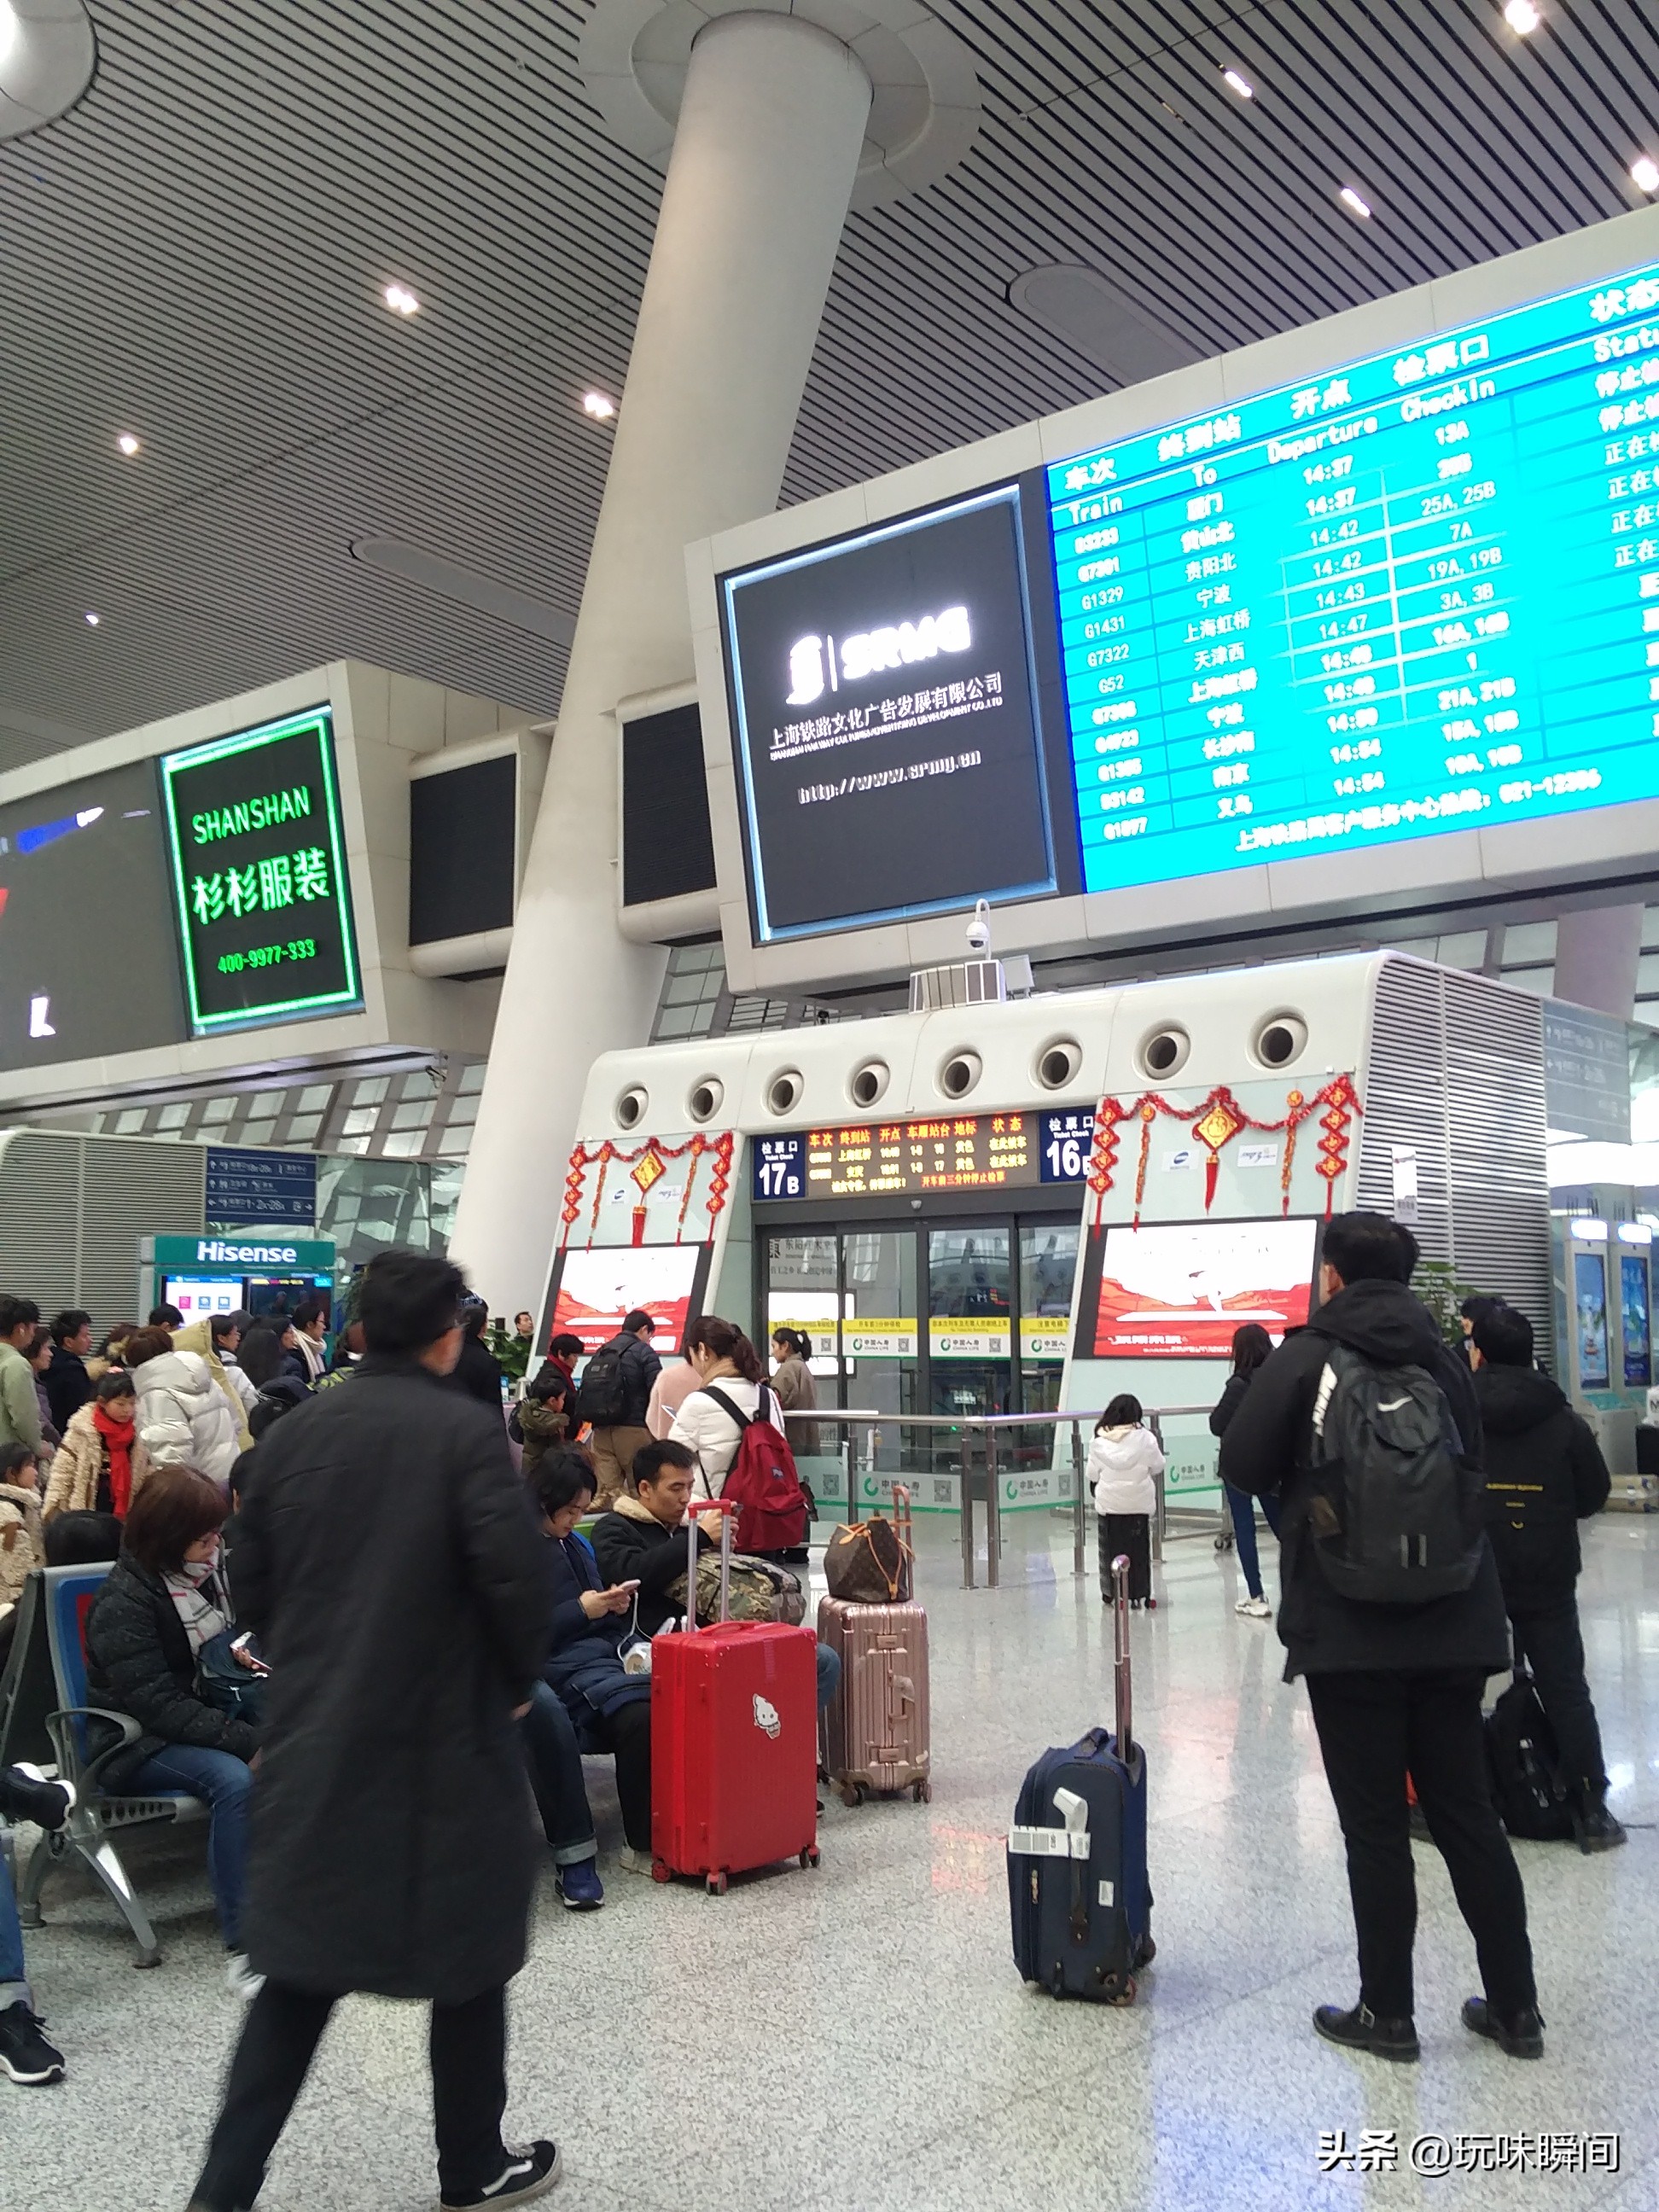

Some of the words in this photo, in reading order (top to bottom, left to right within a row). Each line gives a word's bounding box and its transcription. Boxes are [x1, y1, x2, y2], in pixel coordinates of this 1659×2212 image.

[1064, 457, 1117, 491] 车次
[1291, 378, 1352, 421] 开点
[1393, 334, 1489, 387] 检票口
[1588, 277, 1659, 323] 状态
[1069, 494, 1123, 525] Train
[1191, 464, 1218, 487] To
[1267, 414, 1377, 464] Departure
[1303, 455, 1353, 486] 14:37
[1306, 486, 1357, 517] 14:37
[1081, 586, 1124, 610] G1329
[1185, 552, 1237, 582] 贵阳北
[1310, 519, 1359, 547] 14:42
[1421, 493, 1459, 517] 25A,
[1462, 480, 1497, 505] 25B
[1085, 615, 1126, 639] G1431
[1196, 584, 1231, 608] 宁波
[1313, 550, 1362, 578] 14:42
[1449, 521, 1473, 542] 7A
[1087, 643, 1130, 667] G7322
[1183, 608, 1251, 643] 上海虹桥
[1315, 582, 1365, 609] 14:43
[1428, 557, 1464, 580] 19A,
[1469, 546, 1503, 572] 19B
[1098, 674, 1124, 694] G52
[1194, 641, 1245, 671] 天津西
[1318, 614, 1368, 640] 14:47
[1440, 590, 1468, 611] 3A,
[1472, 582, 1494, 602] 3B
[1466, 652, 1477, 672] 1
[769, 671, 1003, 751] 上海铁路文化广告发展有限公司
[192, 785, 311, 845] SHANSHAN
[191, 846, 330, 925] 杉杉服装
[217, 938, 317, 975] 400-9977-333
[809, 1132, 834, 1149] 车次
[879, 1126, 901, 1142] 开点
[954, 1120, 977, 1136] 地标
[992, 1115, 1022, 1133] 状态
[1049, 1115, 1093, 1132] 检票口
[761, 1140, 798, 1155] 检票口
[759, 1162, 800, 1196] 17B
[922, 1169, 1006, 1189] 开车前三分钟停止检票
[197, 1241, 297, 1263] Hisense
[1019, 1478, 1049, 1489] 中国人寿
